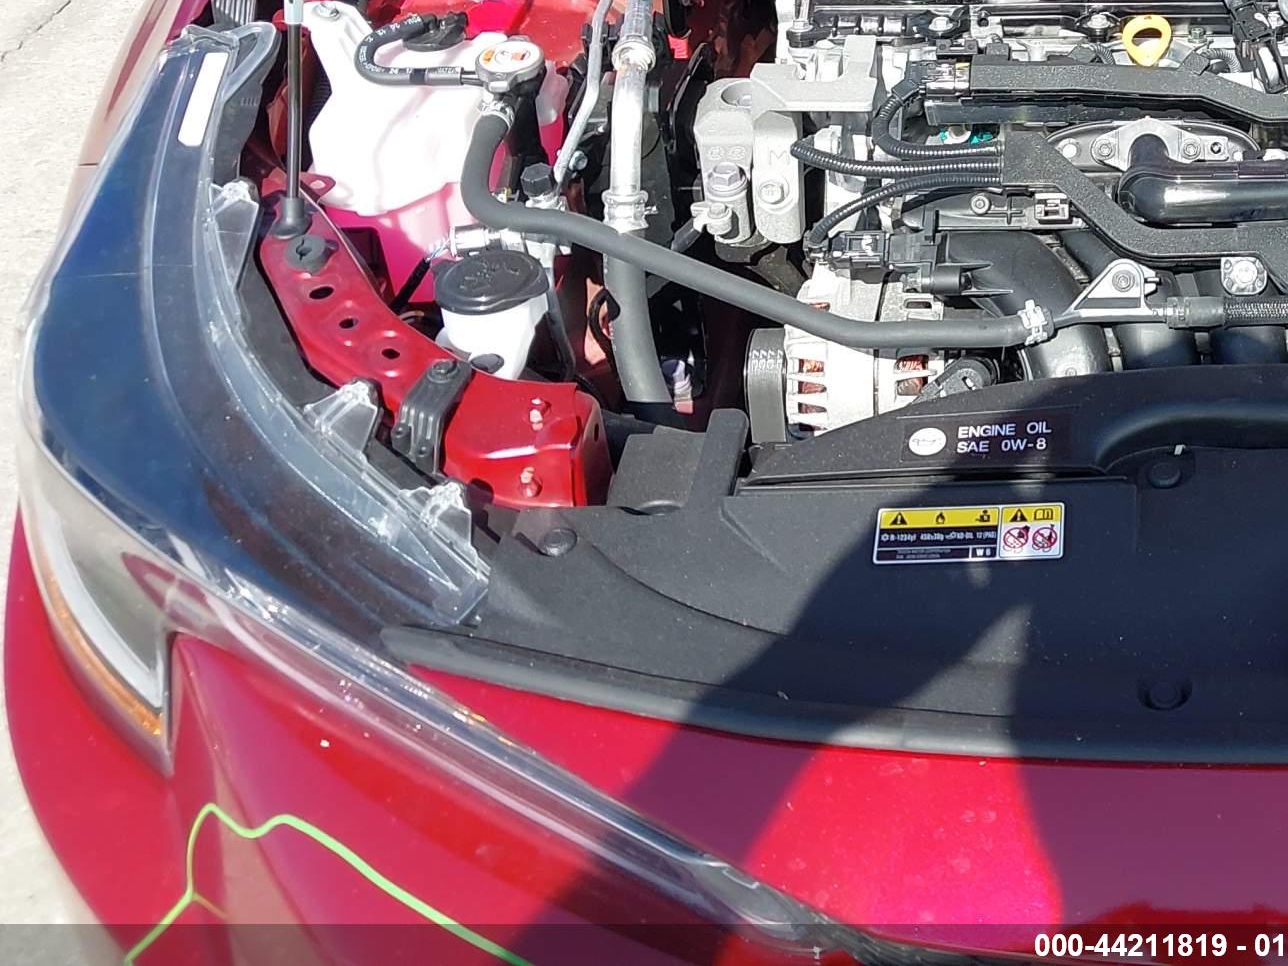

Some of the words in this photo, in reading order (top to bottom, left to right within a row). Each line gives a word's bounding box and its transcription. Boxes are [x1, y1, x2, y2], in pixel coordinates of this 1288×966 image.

[768, 150, 790, 166] M
[957, 423, 1016, 439] ENGINE
[1026, 421, 1052, 435] OIL
[956, 440, 990, 453] SAE
[1001, 437, 1047, 452] 0W-8
